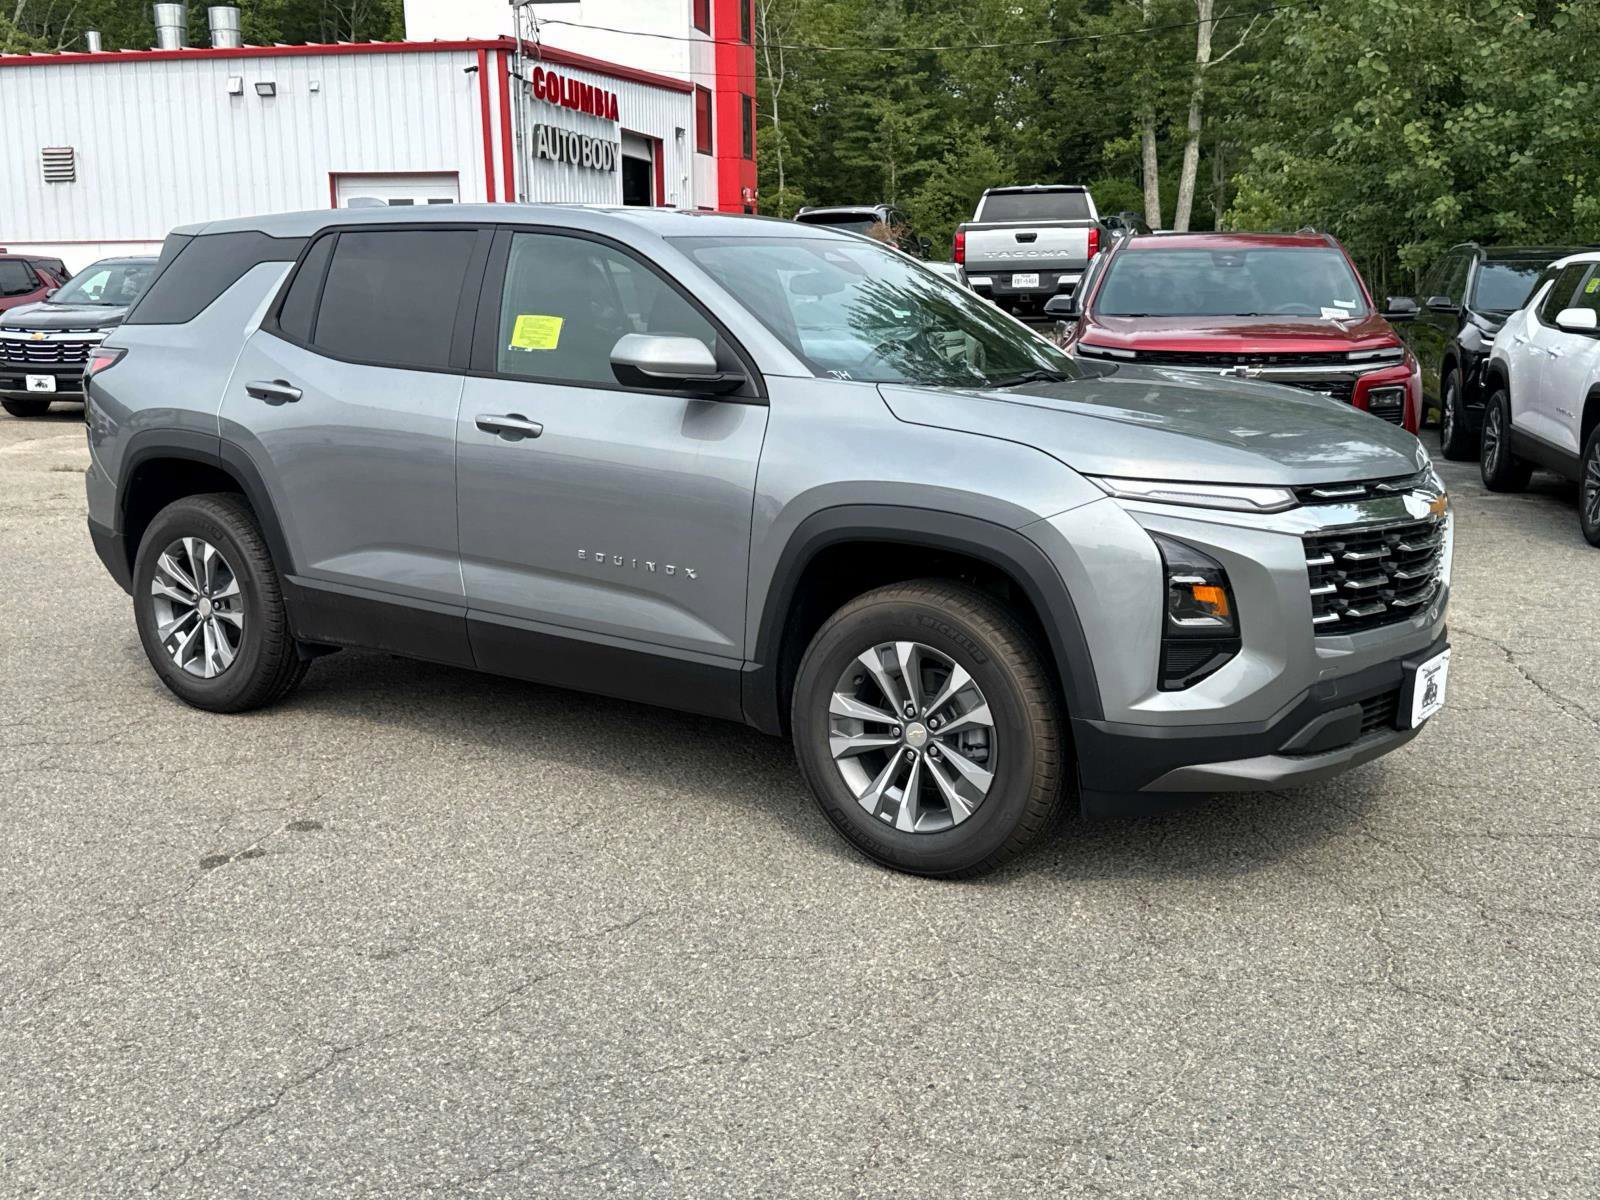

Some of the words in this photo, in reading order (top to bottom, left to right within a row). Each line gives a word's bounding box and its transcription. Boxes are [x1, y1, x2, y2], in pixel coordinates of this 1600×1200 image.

[533, 66, 620, 122] COLUMBIA
[535, 124, 580, 165] AUTO
[582, 135, 620, 171] BODY
[984, 249, 1069, 258] TACOMA
[577, 549, 698, 579] EQUINOX
